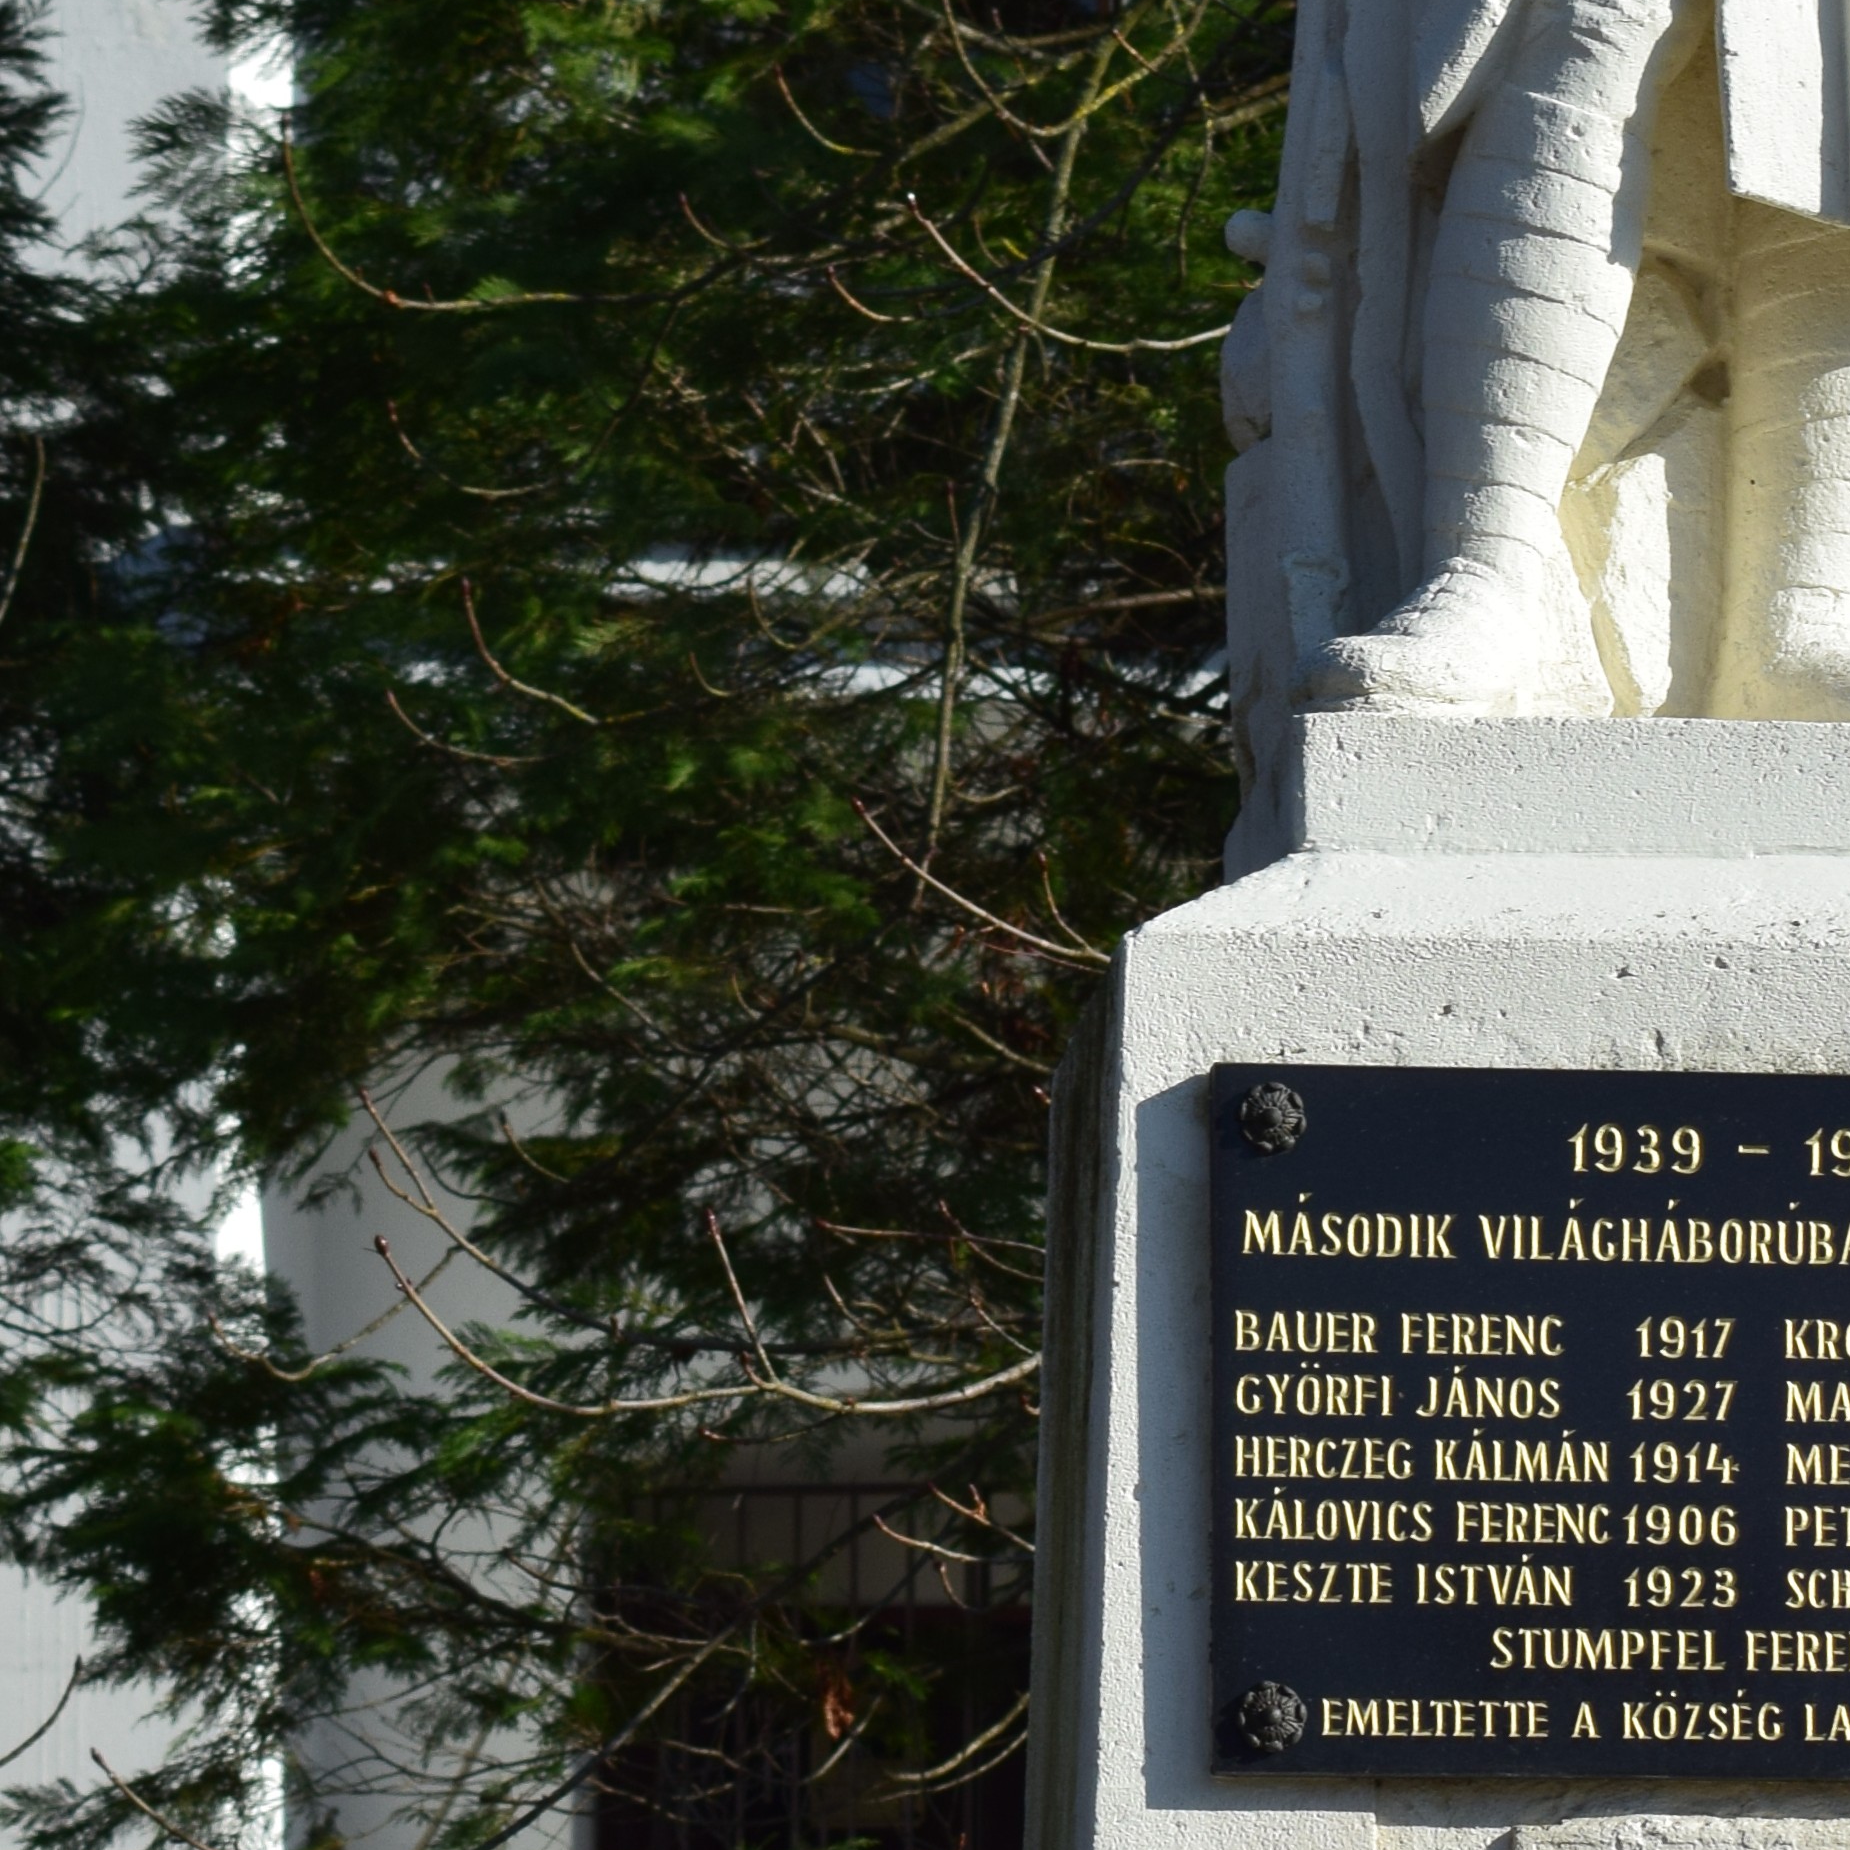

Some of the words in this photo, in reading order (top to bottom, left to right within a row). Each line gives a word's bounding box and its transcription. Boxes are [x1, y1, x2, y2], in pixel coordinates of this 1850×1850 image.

[1568, 1124, 1705, 1175] 1939
[1241, 1192, 1458, 1260] MÁSODIK
[1234, 1309, 1378, 1354] BAUER
[1401, 1312, 1566, 1356] FERENC
[1634, 1316, 1738, 1359] 1917
[1235, 1362, 1394, 1417] GYÖRFI
[1416, 1365, 1561, 1418] JÁNOS
[1626, 1379, 1738, 1421] 1927
[1234, 1435, 1414, 1479] HERCZEG
[1434, 1427, 1610, 1483] KÁLMÁN
[1629, 1442, 1741, 1485] 1914
[1234, 1486, 1434, 1542] KÁLOVICS
[1456, 1501, 1612, 1545] FERENC
[1623, 1505, 1740, 1546] 1906
[1234, 1560, 1394, 1603] KESZTE
[1416, 1553, 1573, 1606] ISTVÁN
[1624, 1566, 1739, 1608] 1923
[1489, 1628, 1725, 1671] STUMPFEL
[1320, 1700, 1549, 1741] EMELTETTE
[1572, 1702, 1598, 1741] A
[1622, 1689, 1784, 1744] KÖZSÉG
